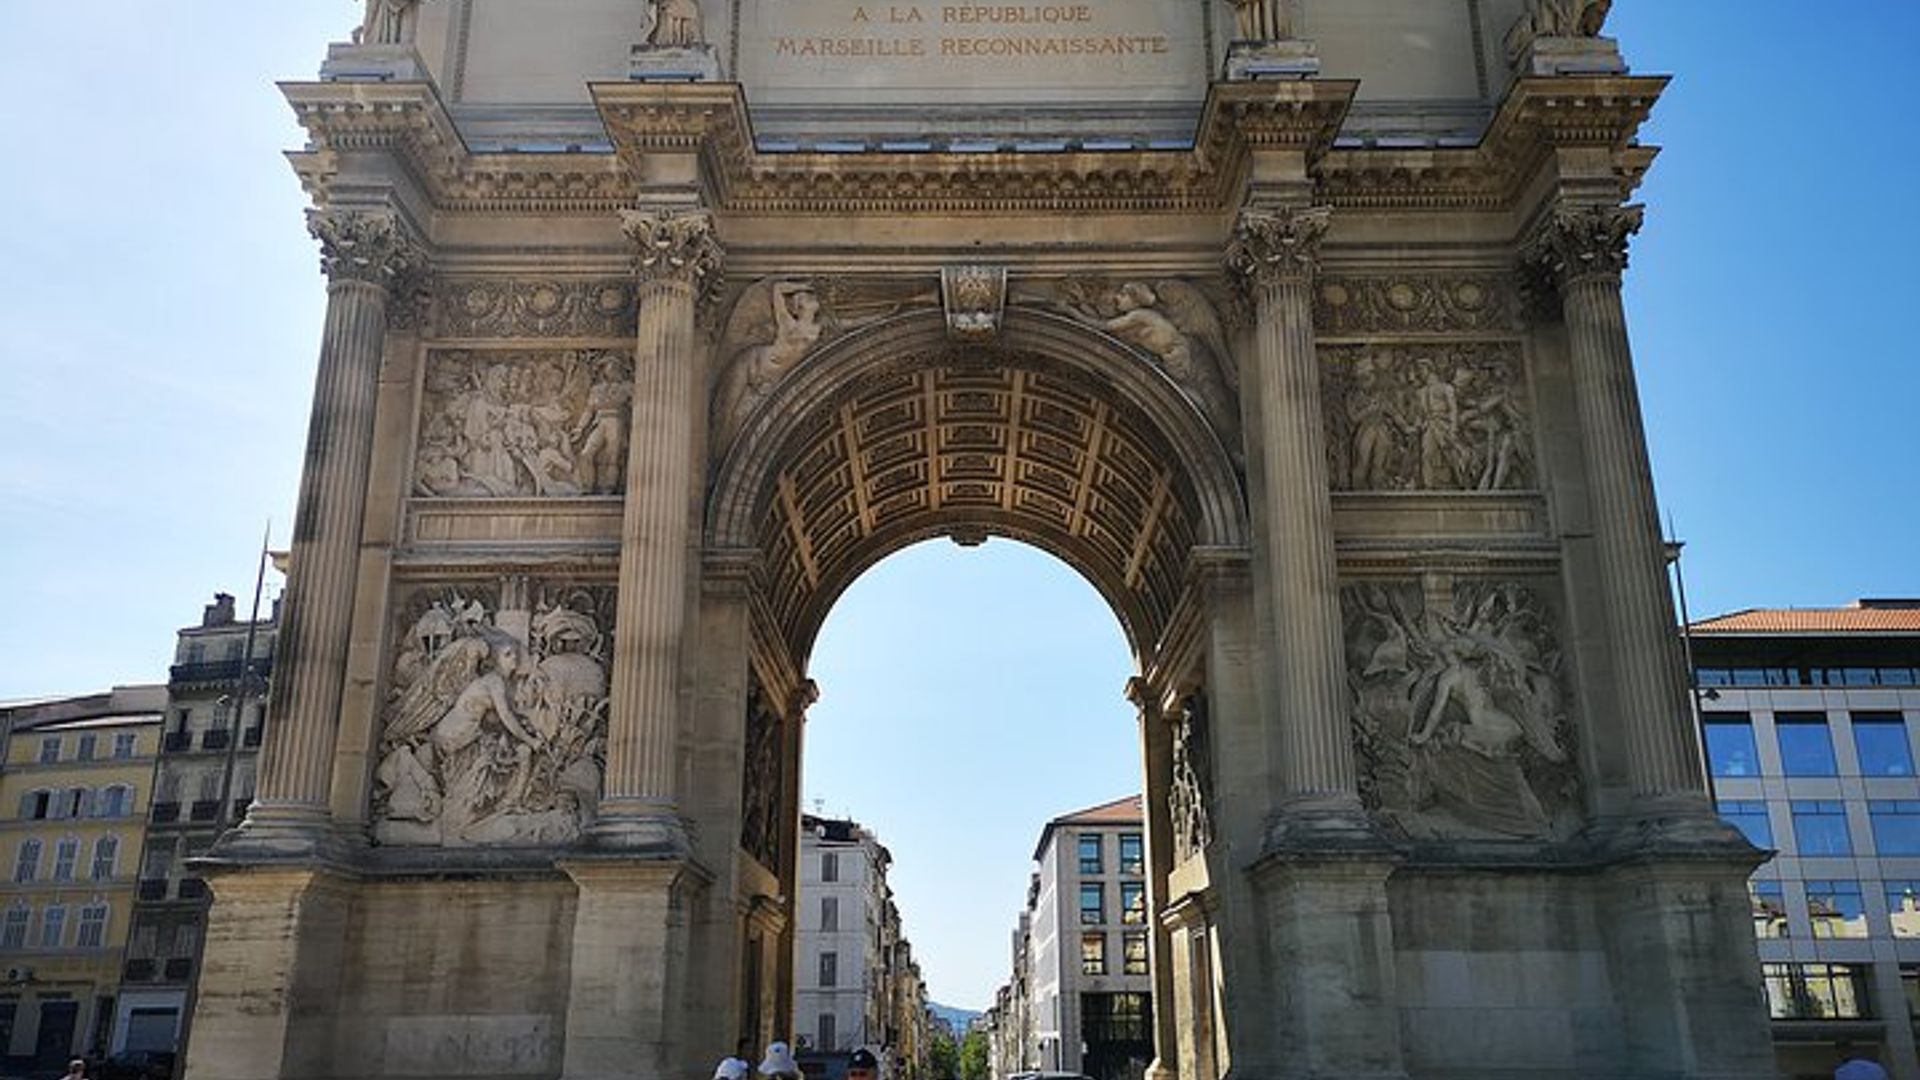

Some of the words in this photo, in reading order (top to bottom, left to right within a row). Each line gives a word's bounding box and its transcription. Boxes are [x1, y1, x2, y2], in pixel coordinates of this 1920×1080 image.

[852, 6, 869, 22] A
[890, 6, 923, 23] LA
[776, 38, 925, 56] MARSEILLE
[940, 36, 1169, 56] RECONNAISSANTE
